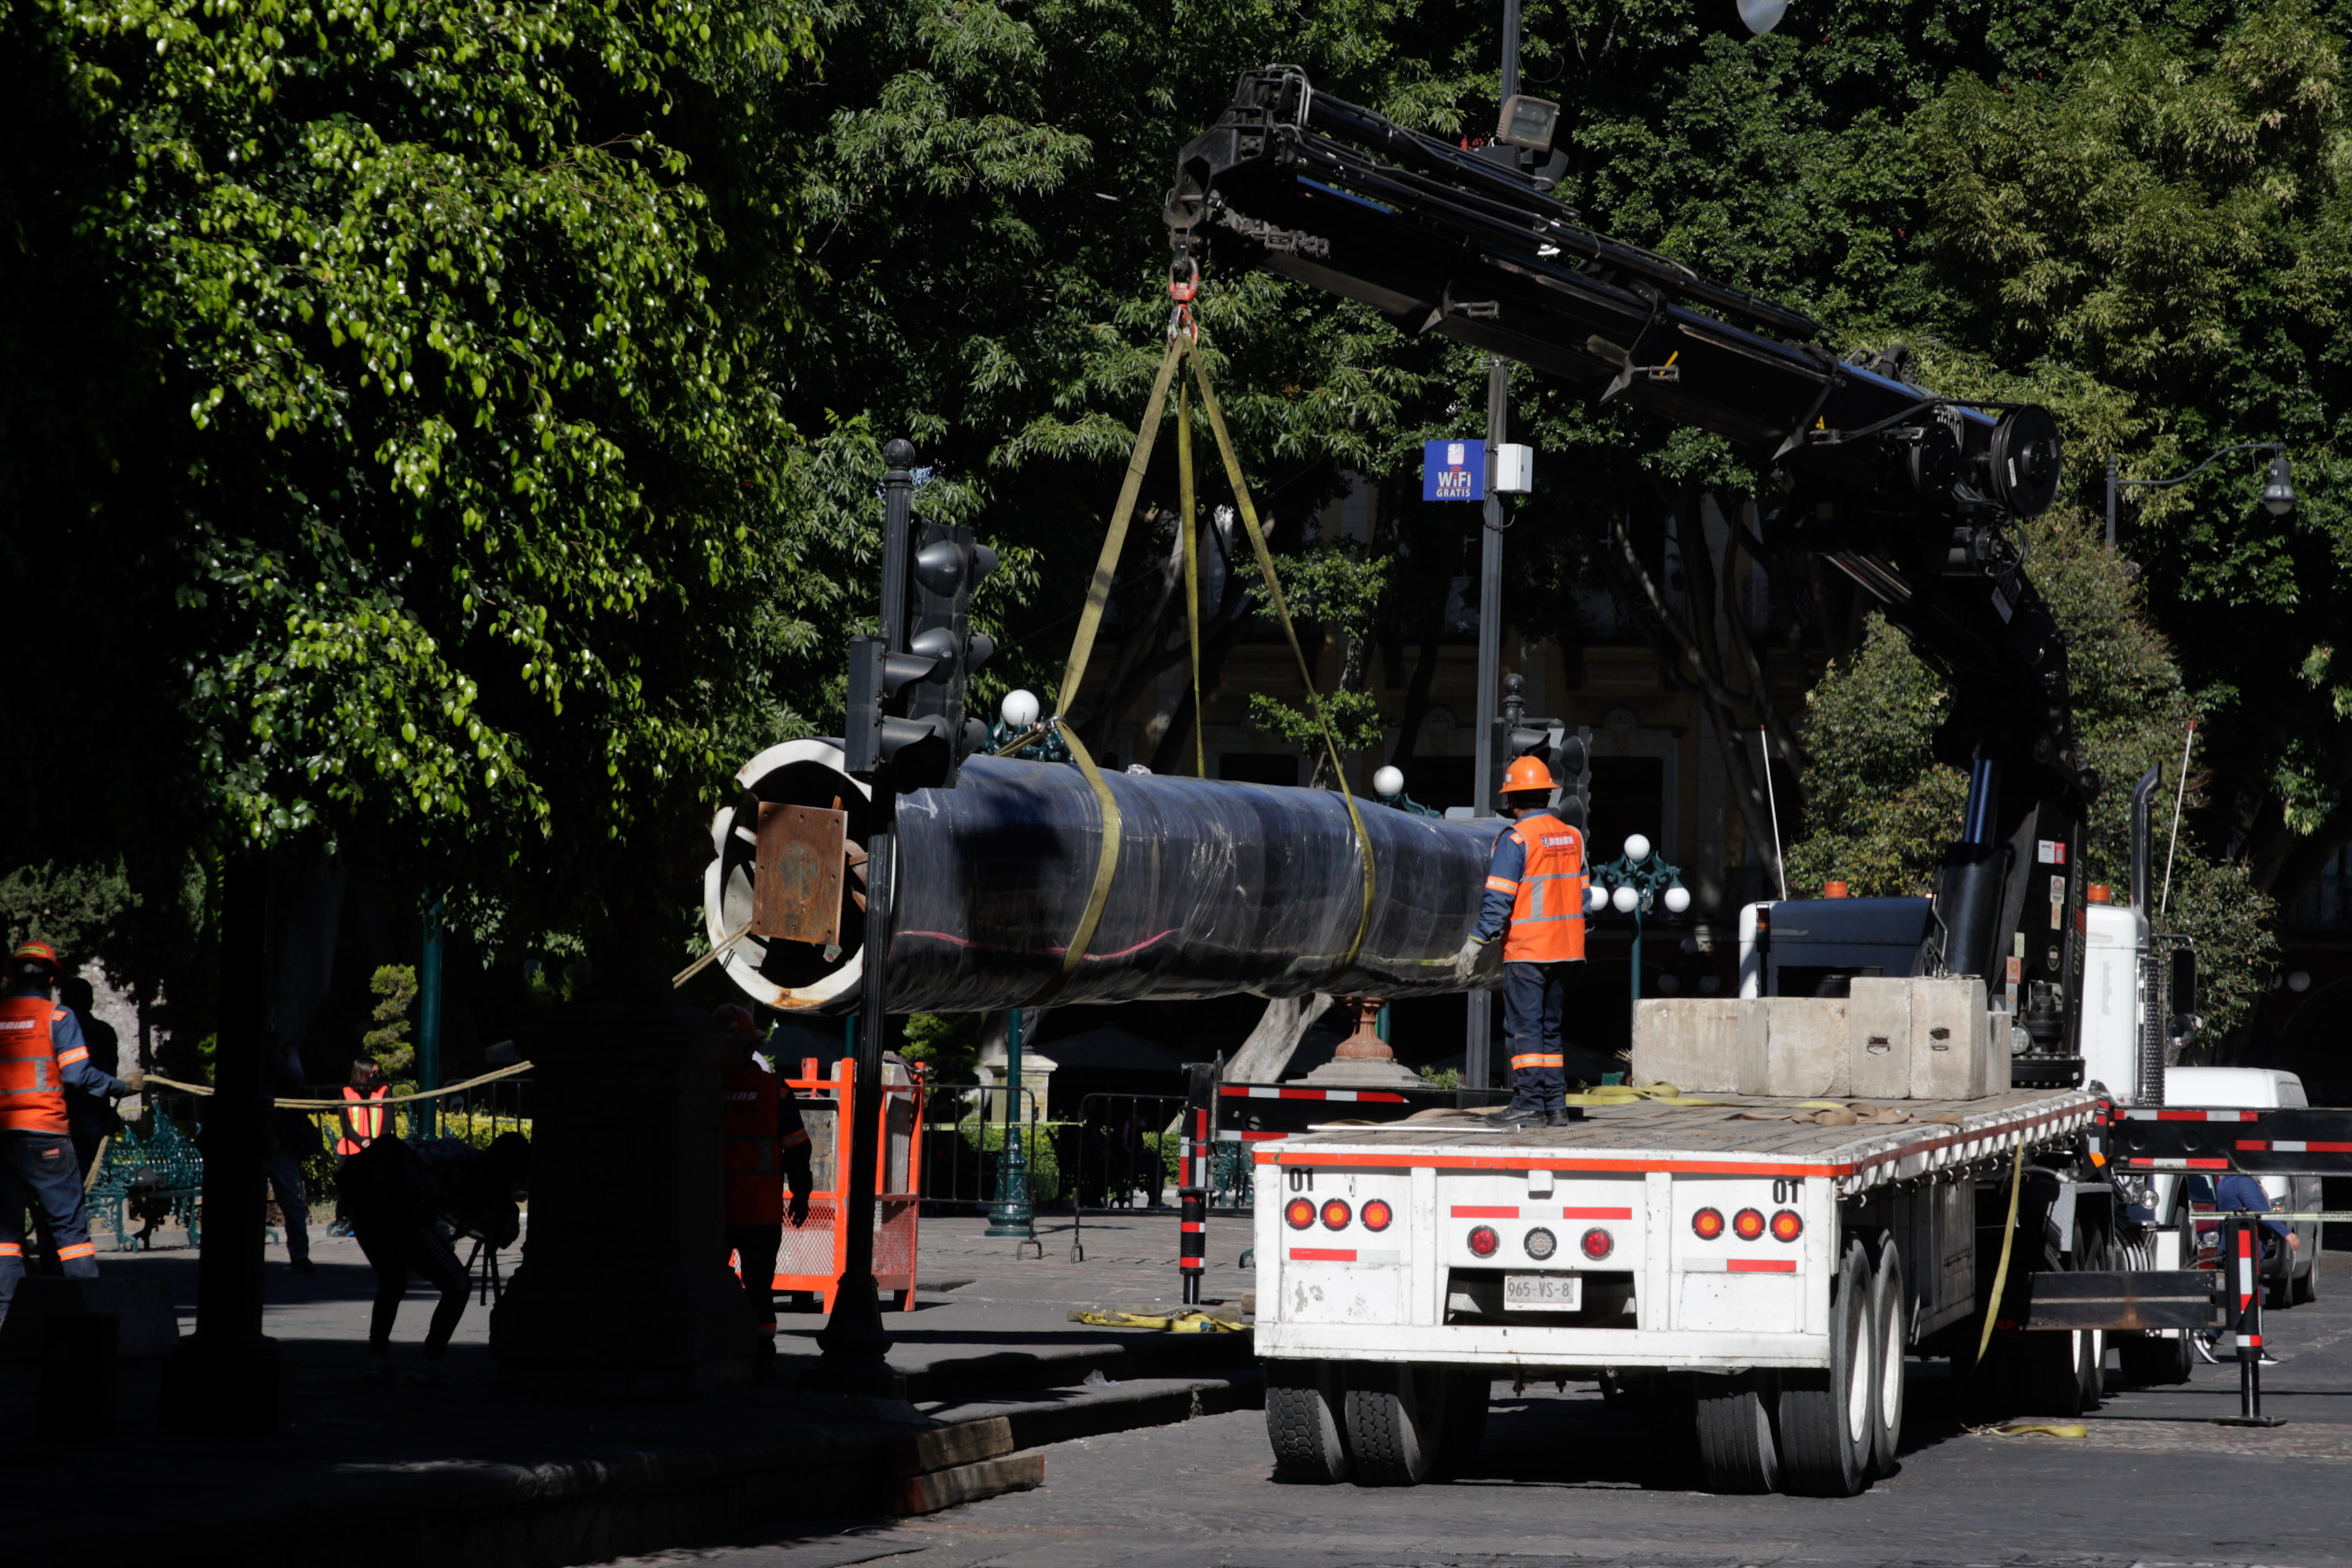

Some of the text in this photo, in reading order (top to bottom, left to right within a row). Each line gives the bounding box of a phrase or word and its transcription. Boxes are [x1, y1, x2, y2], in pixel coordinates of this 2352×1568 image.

[1438, 472, 1472, 488] WiFi
[1436, 488, 1471, 498] GRATIS
[1290, 1167, 1313, 1192] 01
[1773, 1179, 1798, 1204] 01
[1508, 1282, 1569, 1298] 965-VS-8
